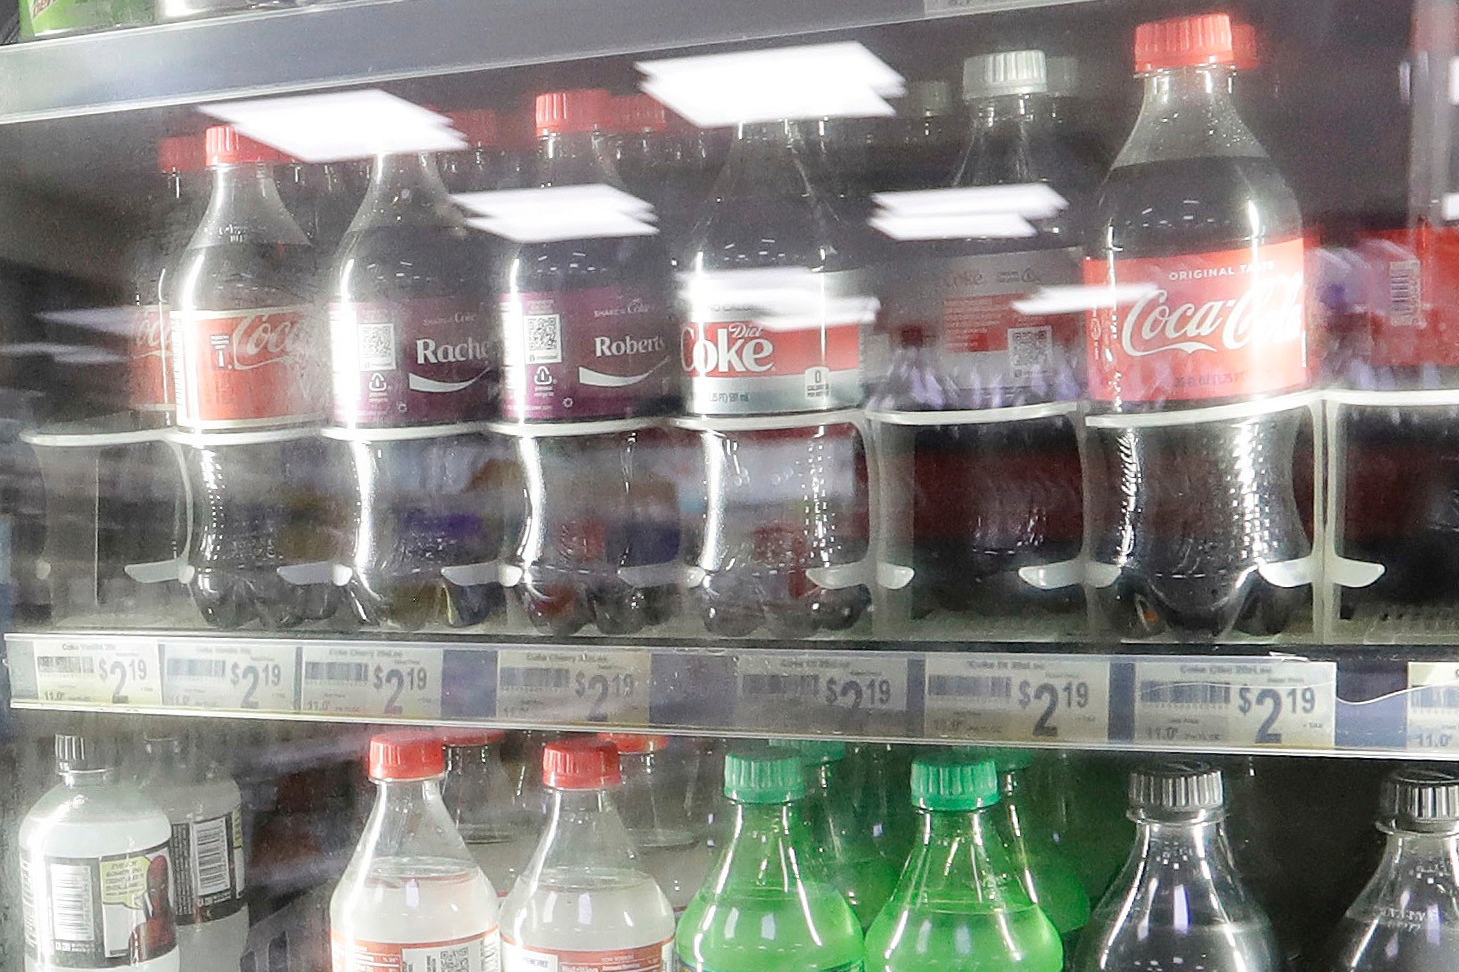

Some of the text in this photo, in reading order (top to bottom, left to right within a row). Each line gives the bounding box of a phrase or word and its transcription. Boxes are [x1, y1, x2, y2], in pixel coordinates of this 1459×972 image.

[1169, 265, 1234, 282] ORIGINAL
[681, 326, 776, 372] Coke
[98, 657, 148, 704] $219
[230, 662, 281, 709] $219
[373, 664, 427, 715] $219
[575, 671, 634, 721] $219
[1017, 680, 1089, 738] $219
[1238, 684, 1315, 744] $219
